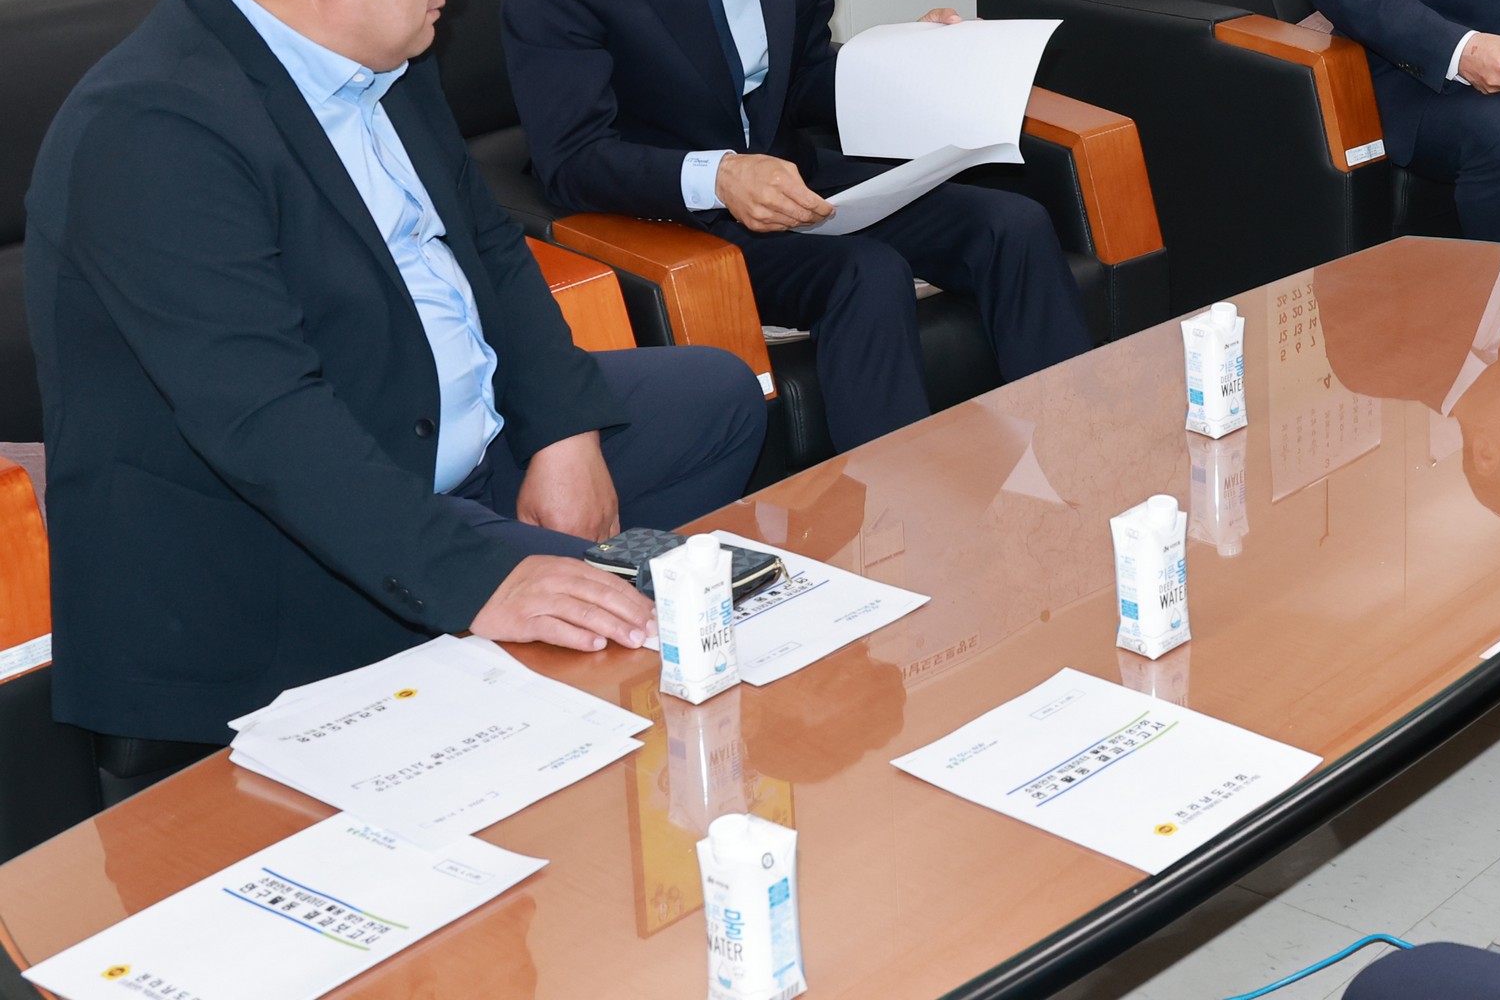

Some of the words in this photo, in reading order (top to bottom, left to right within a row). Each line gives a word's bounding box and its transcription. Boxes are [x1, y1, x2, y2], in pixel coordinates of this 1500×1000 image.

[1220, 374, 1232, 384] DEEP
[1158, 581, 1174, 594] DEEP
[700, 622, 717, 637] DEEP
[1125, 719, 1150, 735] 연구회
[1096, 722, 1165, 762] 결과보고서
[1175, 774, 1247, 818] 전라남도의회
[239, 883, 301, 911] 연구활동
[302, 910, 380, 944] 결과보고서
[362, 921, 392, 934] 연구회
